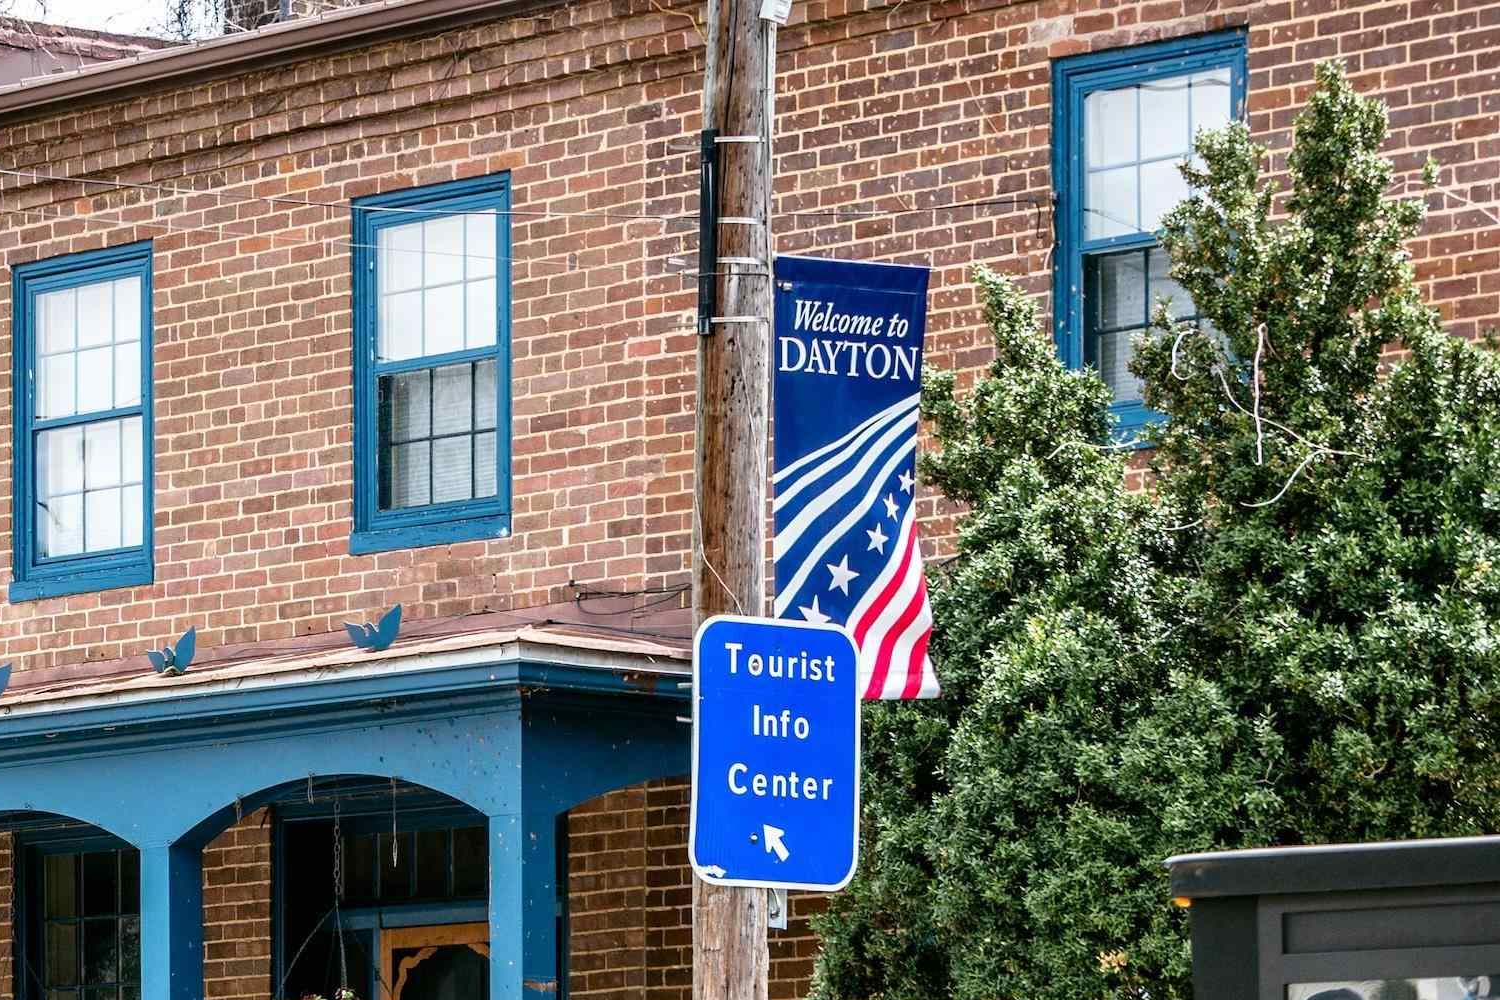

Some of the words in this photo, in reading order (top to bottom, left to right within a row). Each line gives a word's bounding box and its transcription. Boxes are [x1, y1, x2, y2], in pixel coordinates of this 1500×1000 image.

[794, 300, 884, 336] Welcome
[887, 313, 909, 338] to
[778, 336, 919, 381] DAYTON
[724, 642, 835, 682] Tourist
[753, 704, 810, 740] Info
[728, 762, 833, 801] Center
